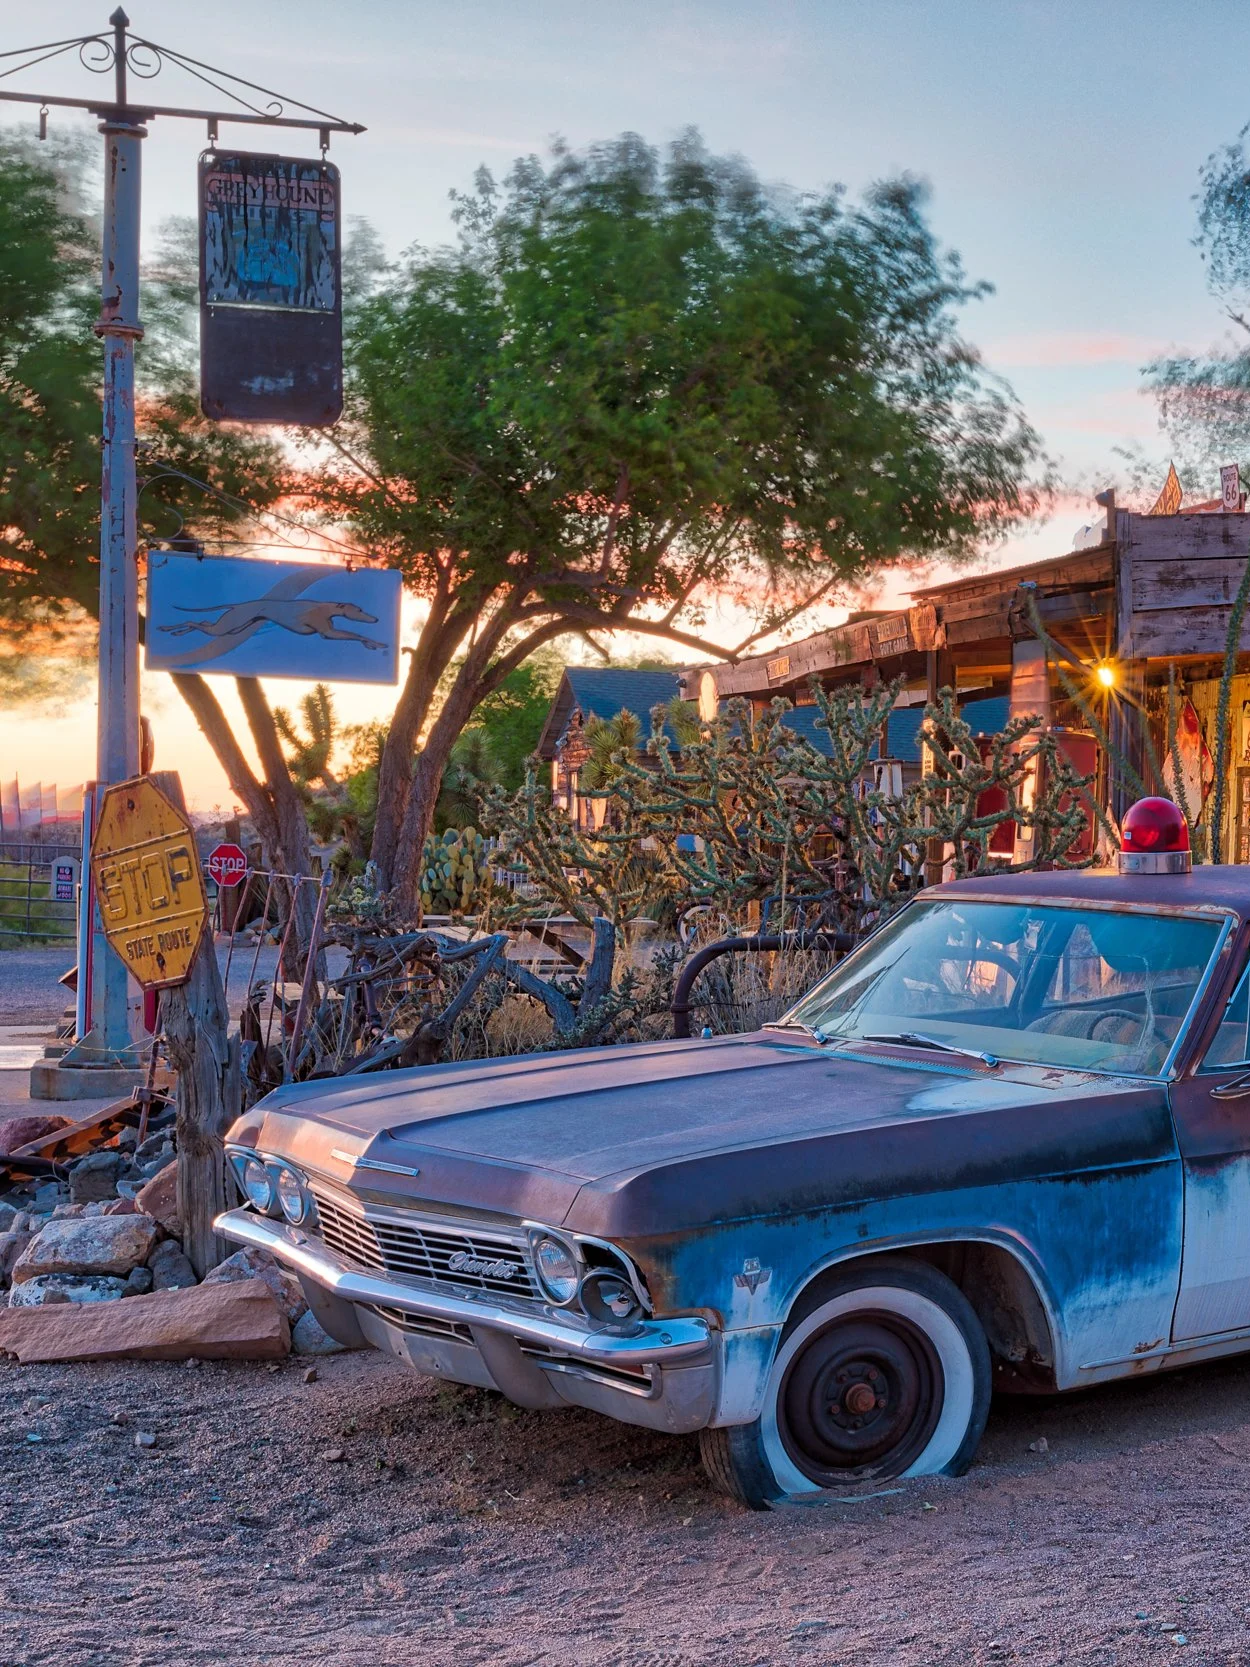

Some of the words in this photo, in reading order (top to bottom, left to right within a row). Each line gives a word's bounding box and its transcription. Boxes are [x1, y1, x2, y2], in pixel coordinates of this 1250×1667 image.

[207, 179, 333, 206] GREYHOUND
[1223, 472, 1237, 482] ROUTE
[1225, 483, 1237, 501] 66
[211, 856, 244, 874] STOP
[100, 845, 194, 922] STOP
[126, 935, 156, 961] STATE
[157, 926, 193, 953] ROUTE
[448, 1250, 519, 1279] Chevrolet
